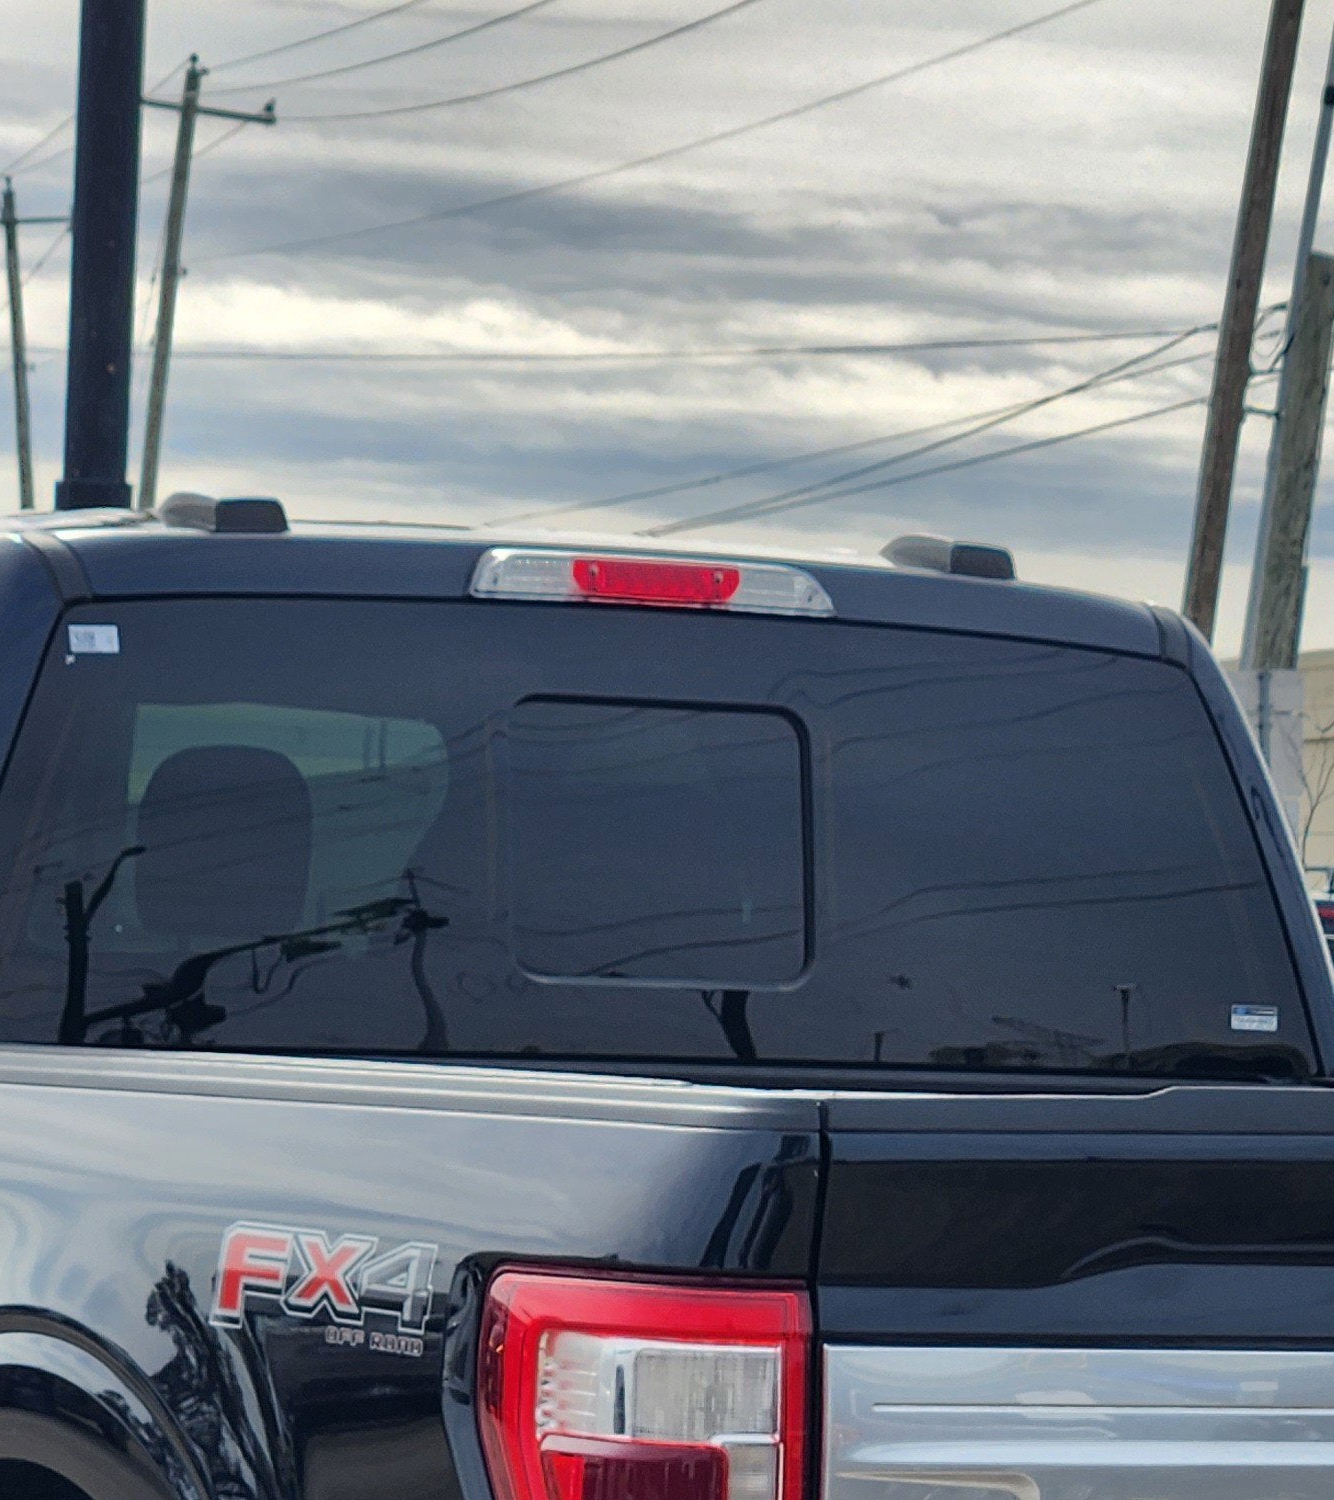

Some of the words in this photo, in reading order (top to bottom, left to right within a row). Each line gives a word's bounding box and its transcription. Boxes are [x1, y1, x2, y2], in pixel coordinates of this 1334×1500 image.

[208, 1220, 437, 1335] FX4
[325, 1325, 364, 1346] OFF
[369, 1331, 423, 1357] ROAD
